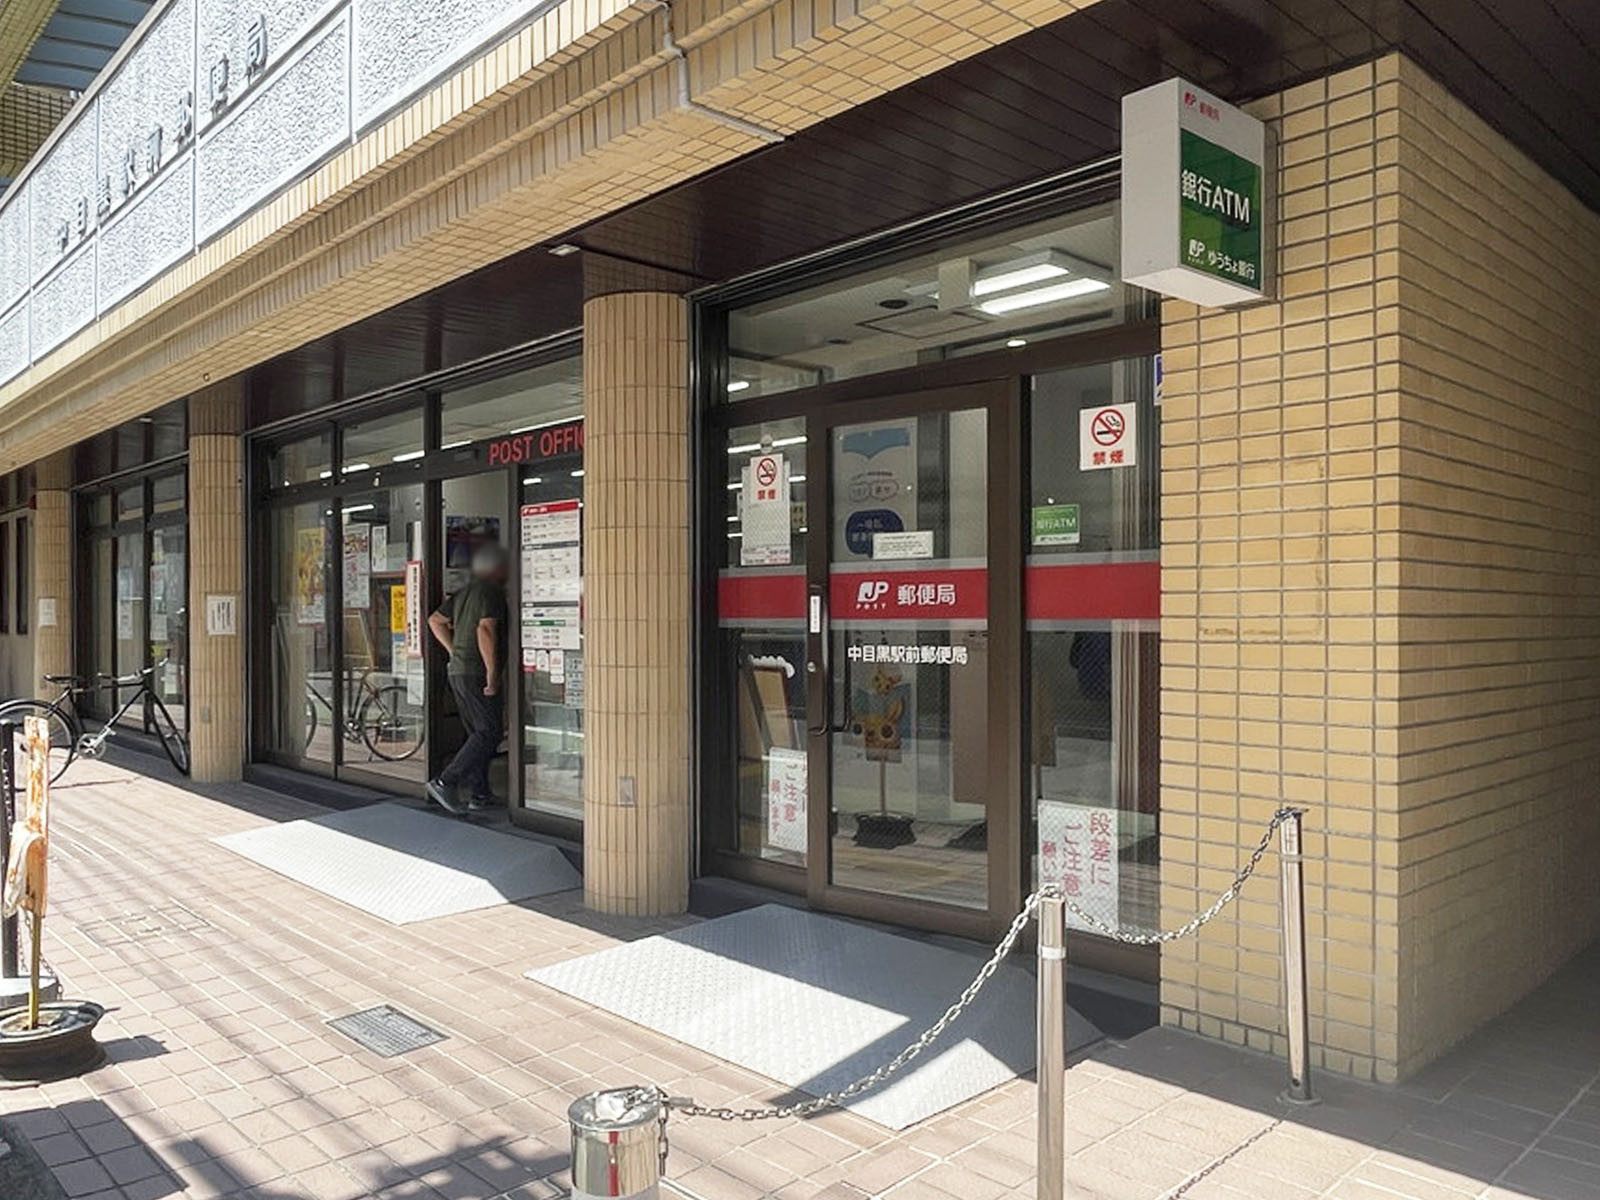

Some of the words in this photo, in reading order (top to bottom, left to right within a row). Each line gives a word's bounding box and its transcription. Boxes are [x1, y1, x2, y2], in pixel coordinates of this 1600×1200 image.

[1181, 169, 1250, 223] 銀行ATM
[1207, 249, 1256, 281] ゆうちょ銀行
[488, 435, 533, 466] POST
[1092, 450, 1124, 465] 禁煙
[897, 584, 956, 606] 郵便局
[847, 645, 969, 665] 中目黒駅前郵便局
